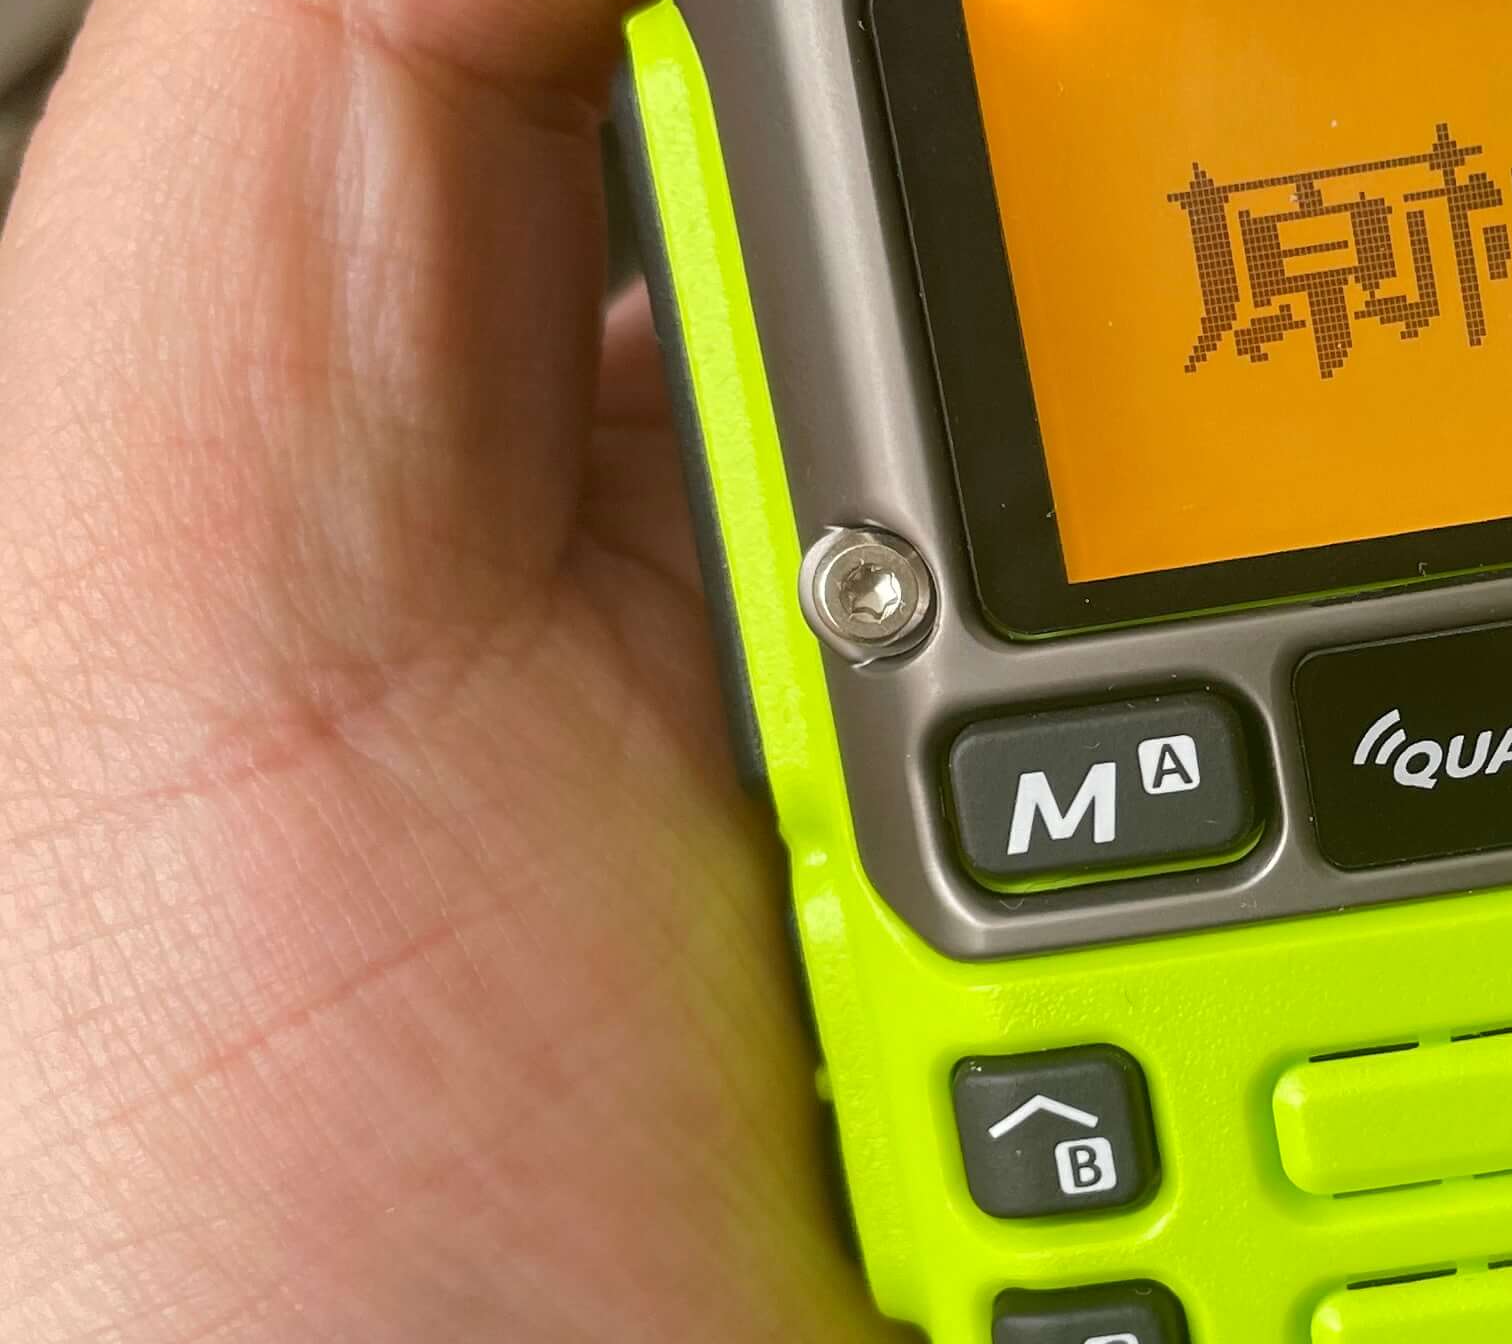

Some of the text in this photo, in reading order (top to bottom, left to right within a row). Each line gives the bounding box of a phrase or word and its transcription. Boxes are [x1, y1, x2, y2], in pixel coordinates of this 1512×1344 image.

[1007, 741, 1194, 856] M A
[1067, 1145, 1103, 1188] B
